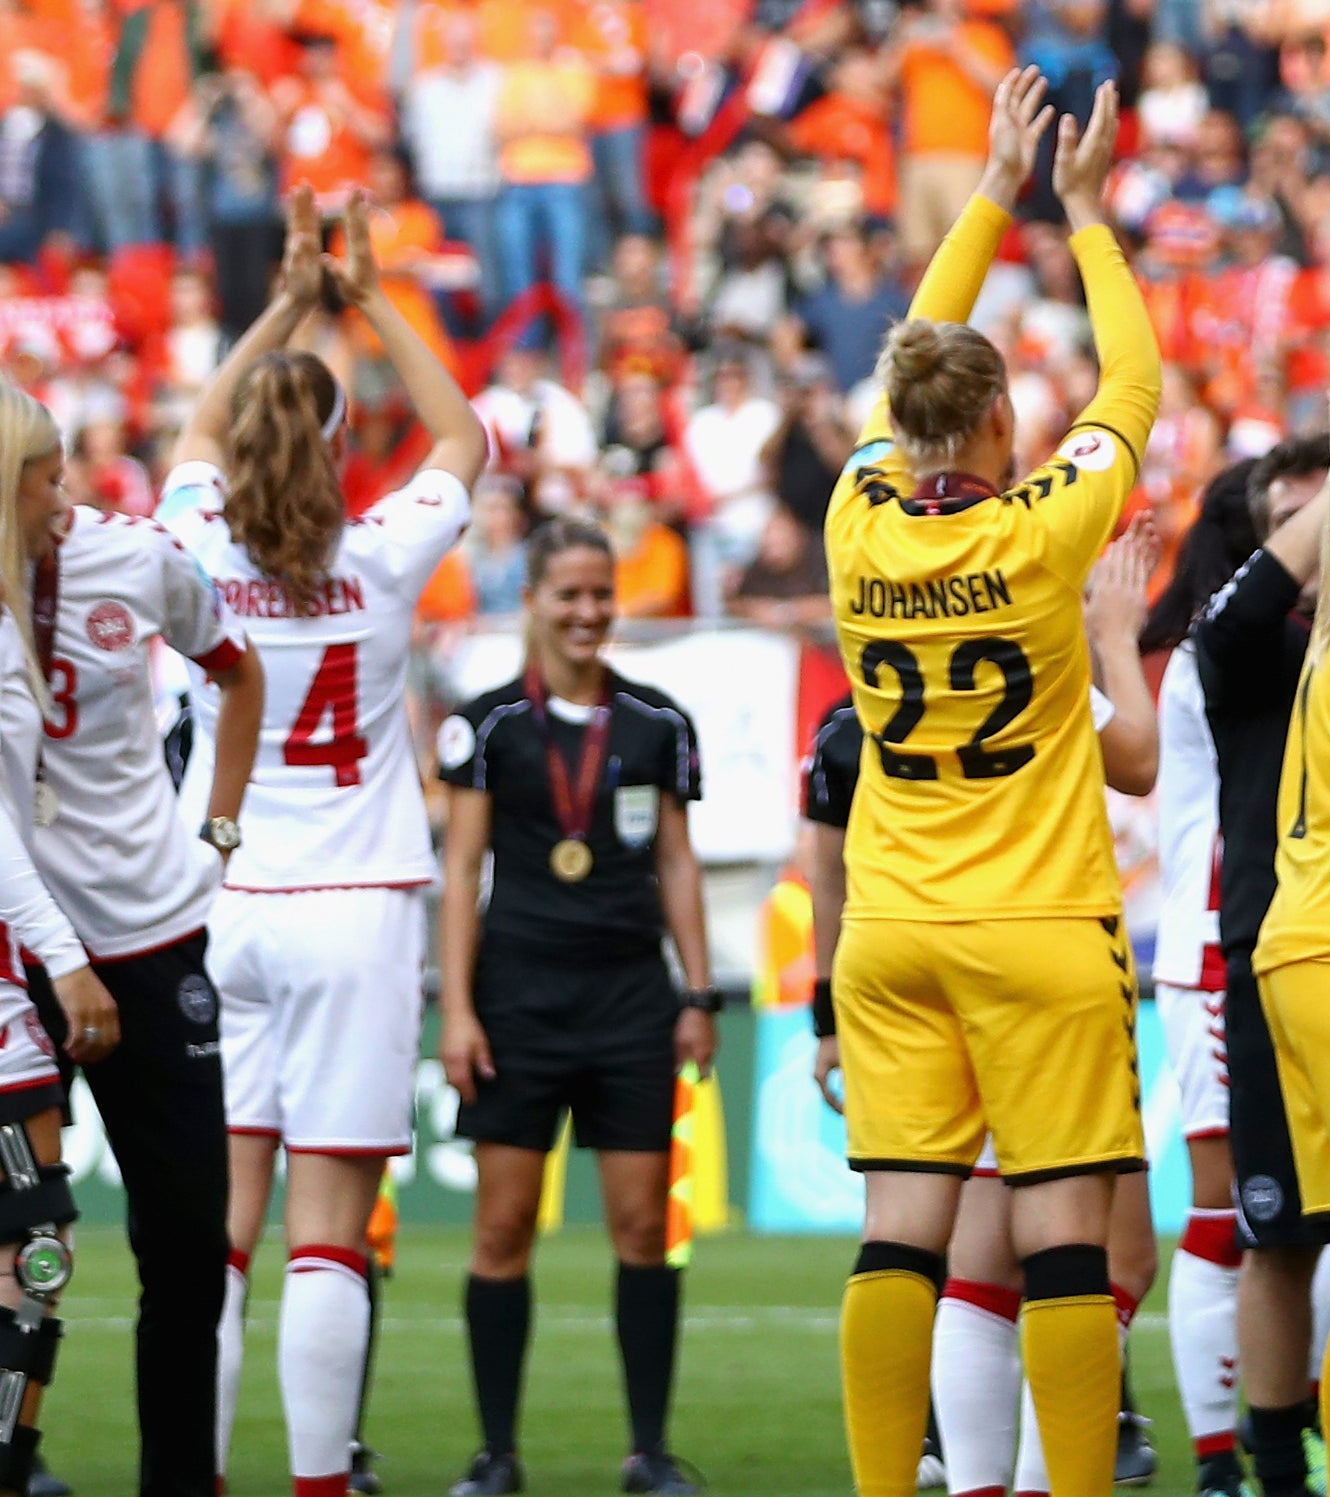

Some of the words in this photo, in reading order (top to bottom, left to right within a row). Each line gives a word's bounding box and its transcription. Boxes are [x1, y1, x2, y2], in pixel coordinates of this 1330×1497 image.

[853, 569, 1013, 618] JOHANSEN
[284, 643, 368, 787] 4
[862, 636, 1037, 781] 22
